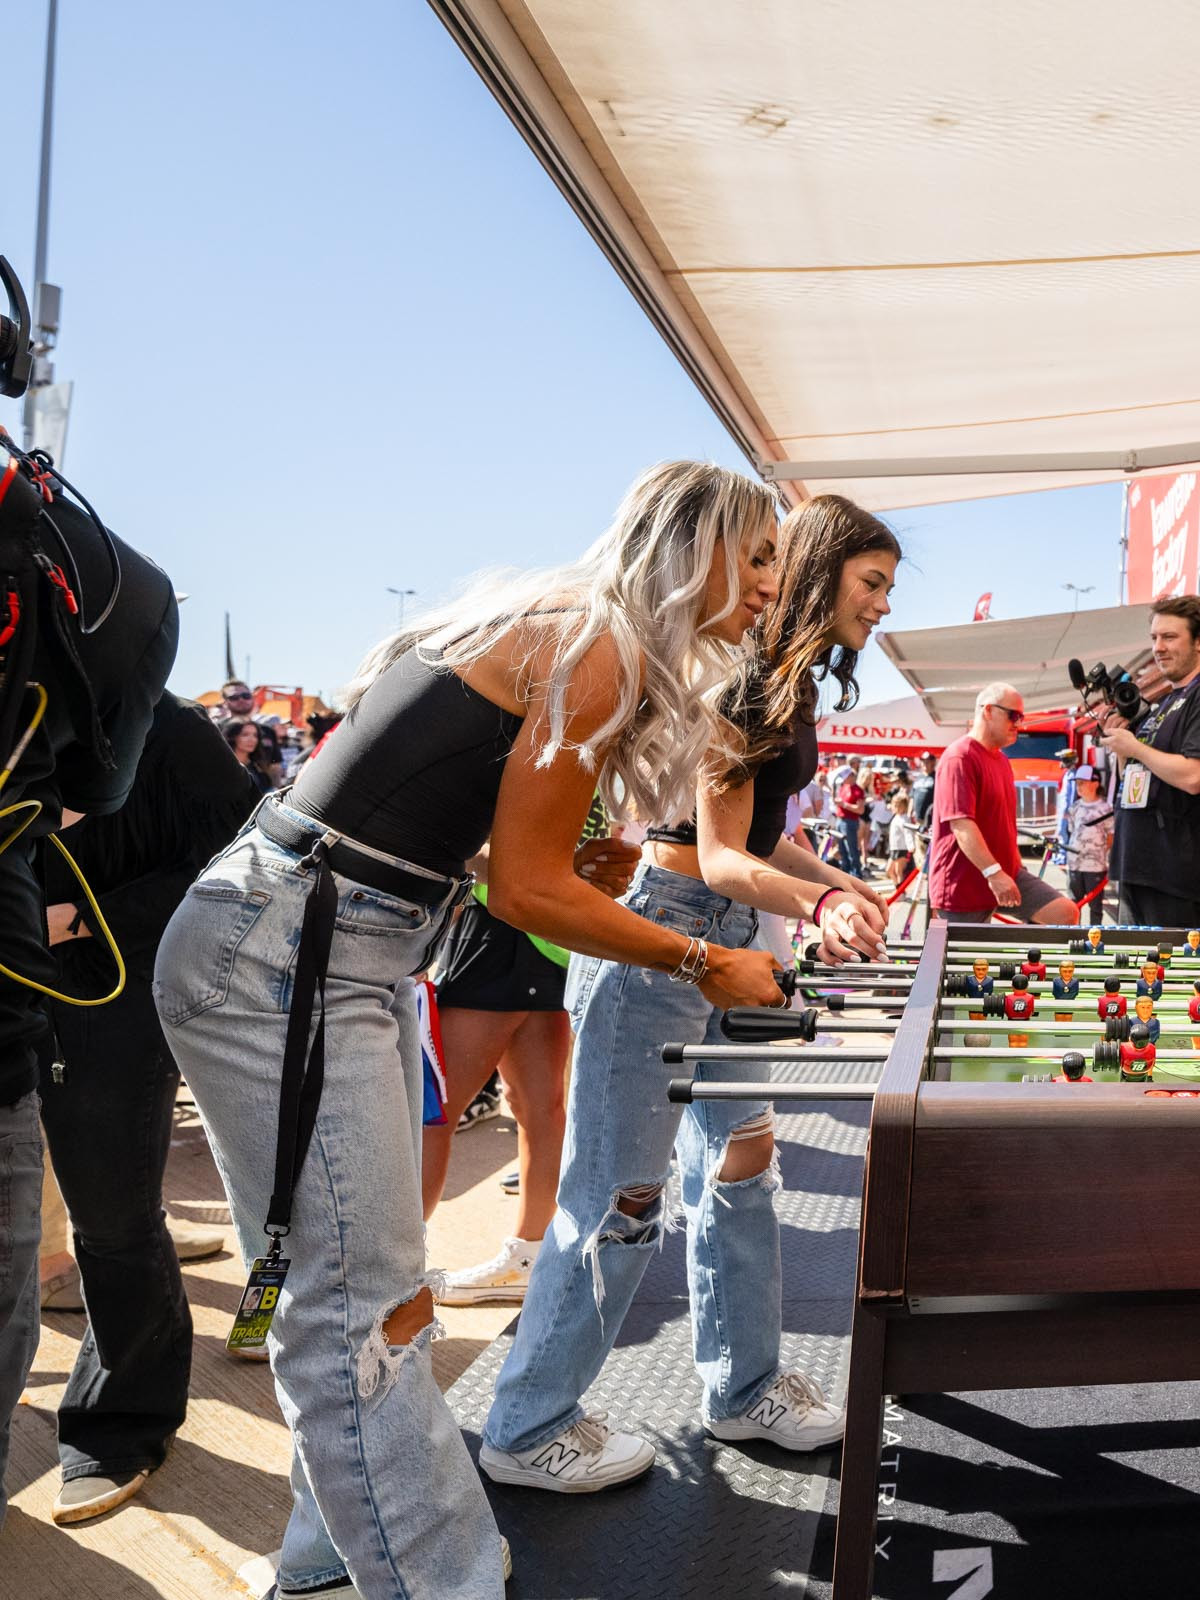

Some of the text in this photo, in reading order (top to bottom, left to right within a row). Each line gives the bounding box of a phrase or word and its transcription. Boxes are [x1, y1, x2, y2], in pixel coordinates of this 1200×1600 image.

[831, 725, 926, 740] HONDA
[1014, 1002, 1025, 1011] 18
[1107, 1004, 1118, 1013] 18
[1131, 1063, 1146, 1071] 18
[260, 1286, 279, 1309] B
[232, 1327, 267, 1340] TRACK
